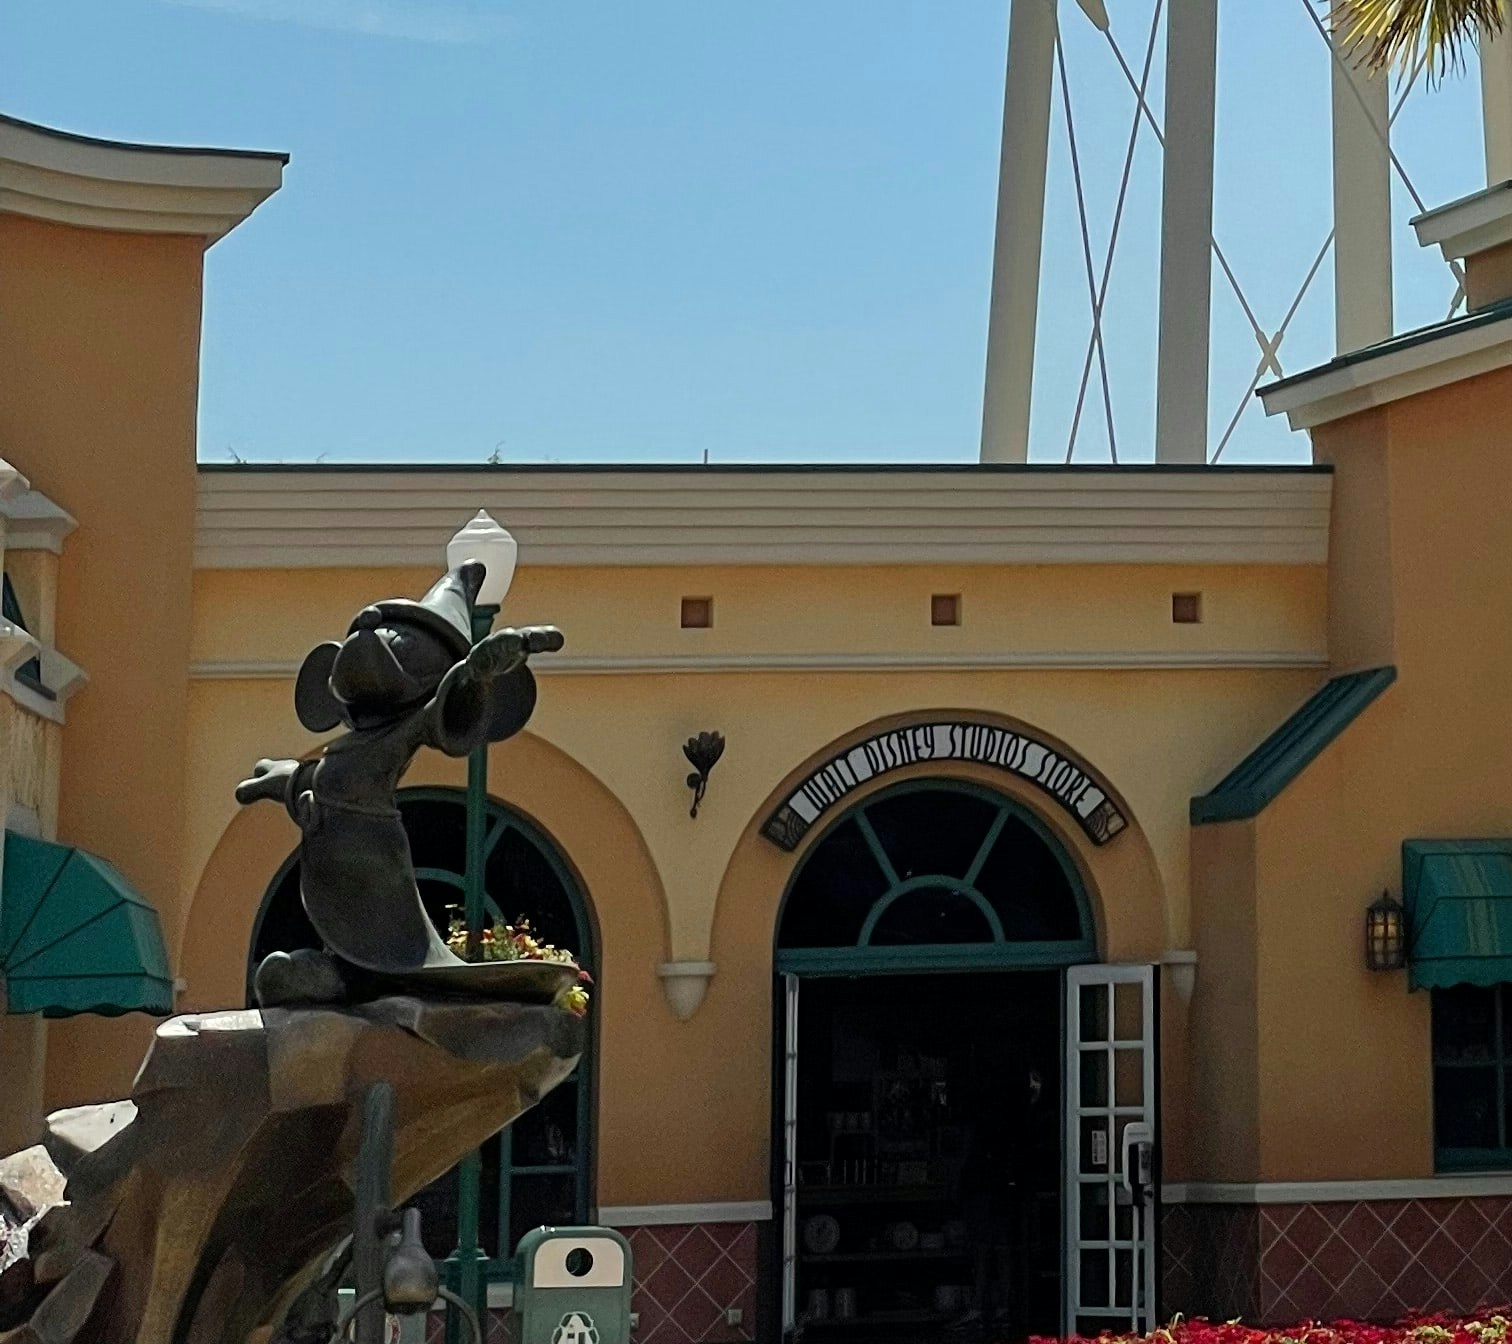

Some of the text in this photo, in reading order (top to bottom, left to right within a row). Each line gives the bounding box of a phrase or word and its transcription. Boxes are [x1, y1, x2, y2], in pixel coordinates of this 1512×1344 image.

[801, 723, 1093, 811] WALT DISNEY STUDIOS STORE
